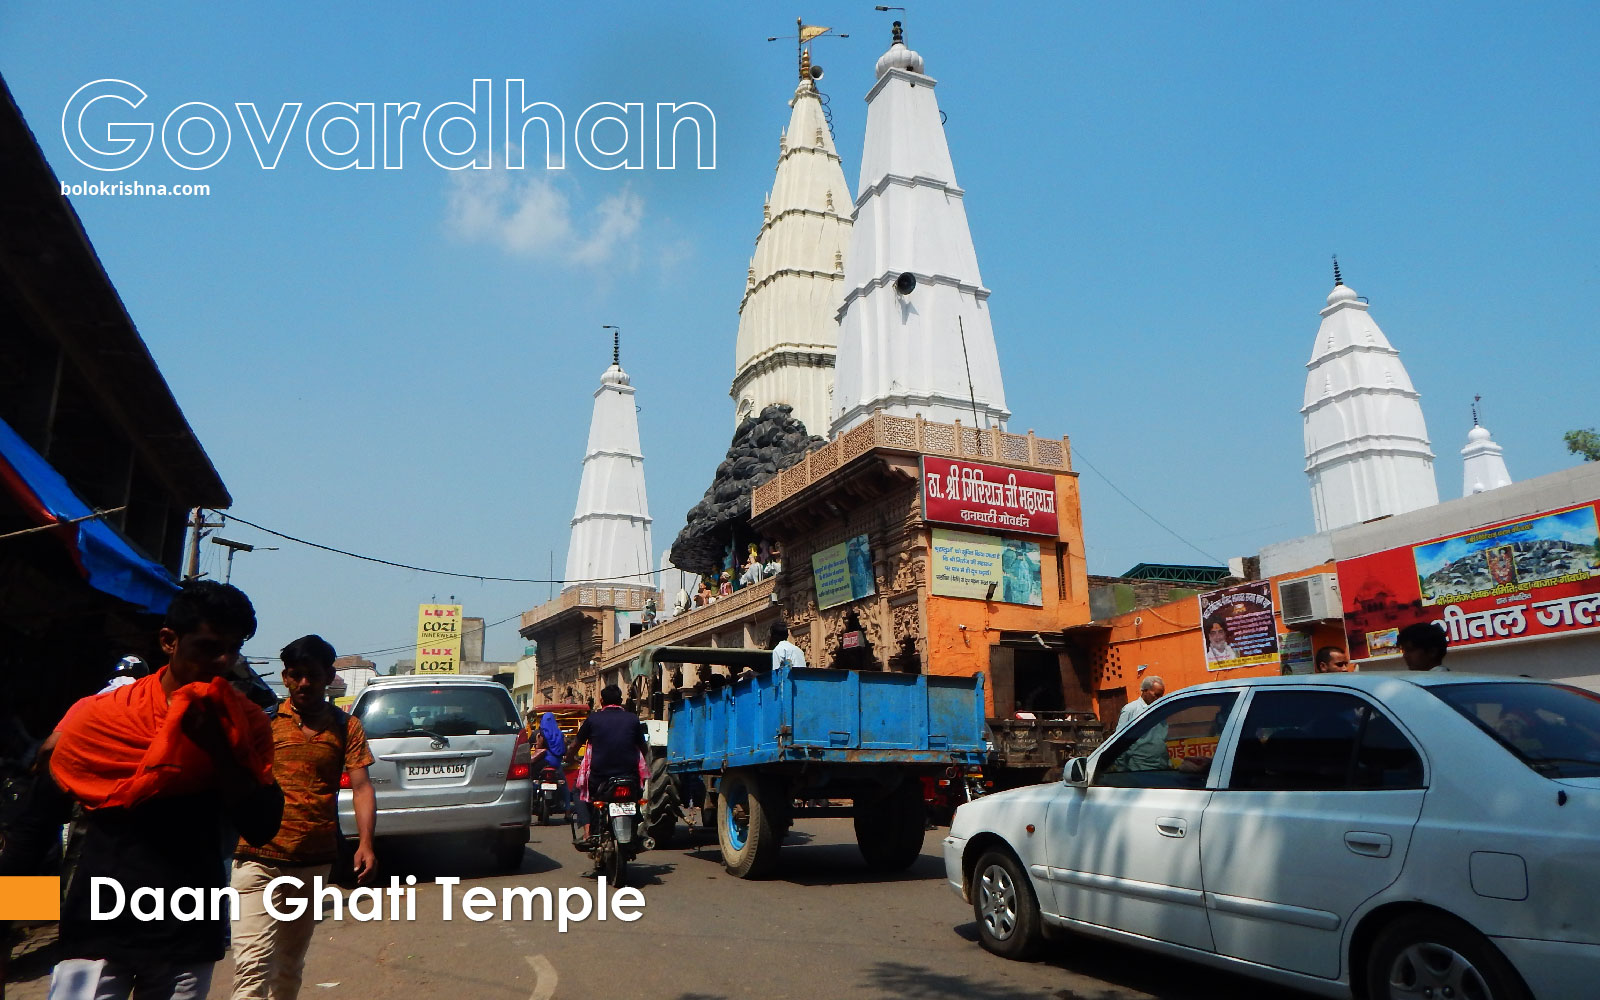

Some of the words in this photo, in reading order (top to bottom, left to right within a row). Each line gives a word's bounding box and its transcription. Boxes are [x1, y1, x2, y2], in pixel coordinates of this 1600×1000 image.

[946, 465, 960, 500] श्री
[962, 468, 1004, 507] गिरिराज
[1004, 473, 1018, 508] जी
[1018, 486, 1055, 515] महाराज
[960, 509, 997, 523] दानघाटी
[998, 512, 1030, 527] गोवर्धन
[423, 619, 457, 632] cozi
[420, 658, 454, 671] cozi
[433, 765, 444, 774] UA
[447, 764, 465, 774] 6166
